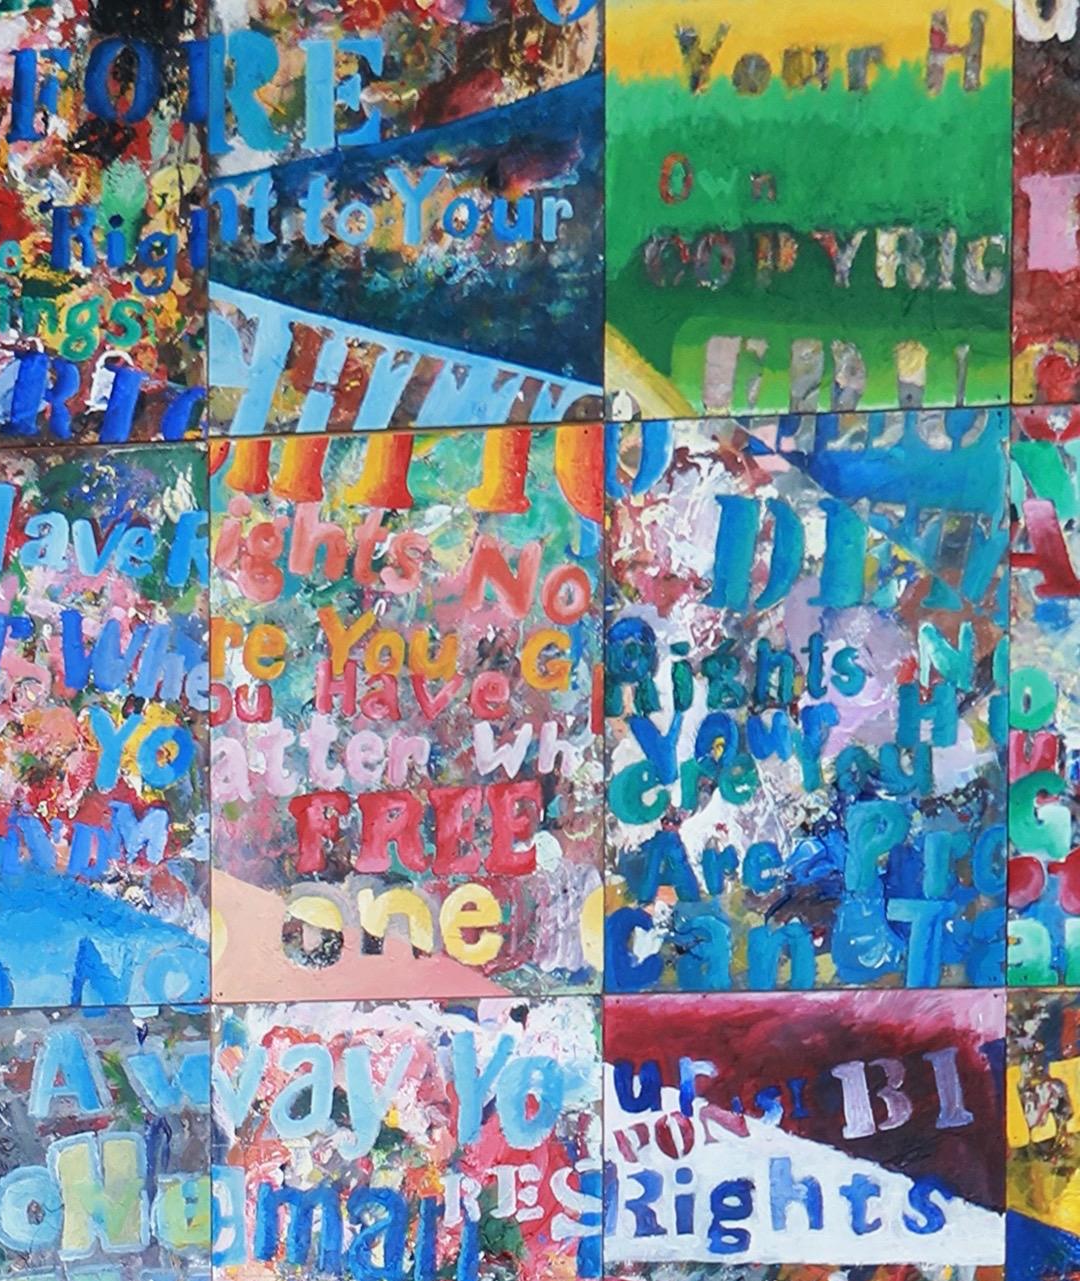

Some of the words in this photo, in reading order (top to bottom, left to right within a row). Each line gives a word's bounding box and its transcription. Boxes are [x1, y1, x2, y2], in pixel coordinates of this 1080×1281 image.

[675, 22, 884, 95] Your
[298, 172, 375, 247] to
[384, 165, 576, 248] Your
[466, 534, 593, 626] No
[317, 604, 459, 681] You
[288, 781, 544, 876] FREE
[281, 882, 505, 969] one
[575, 1155, 957, 1255] Rights
